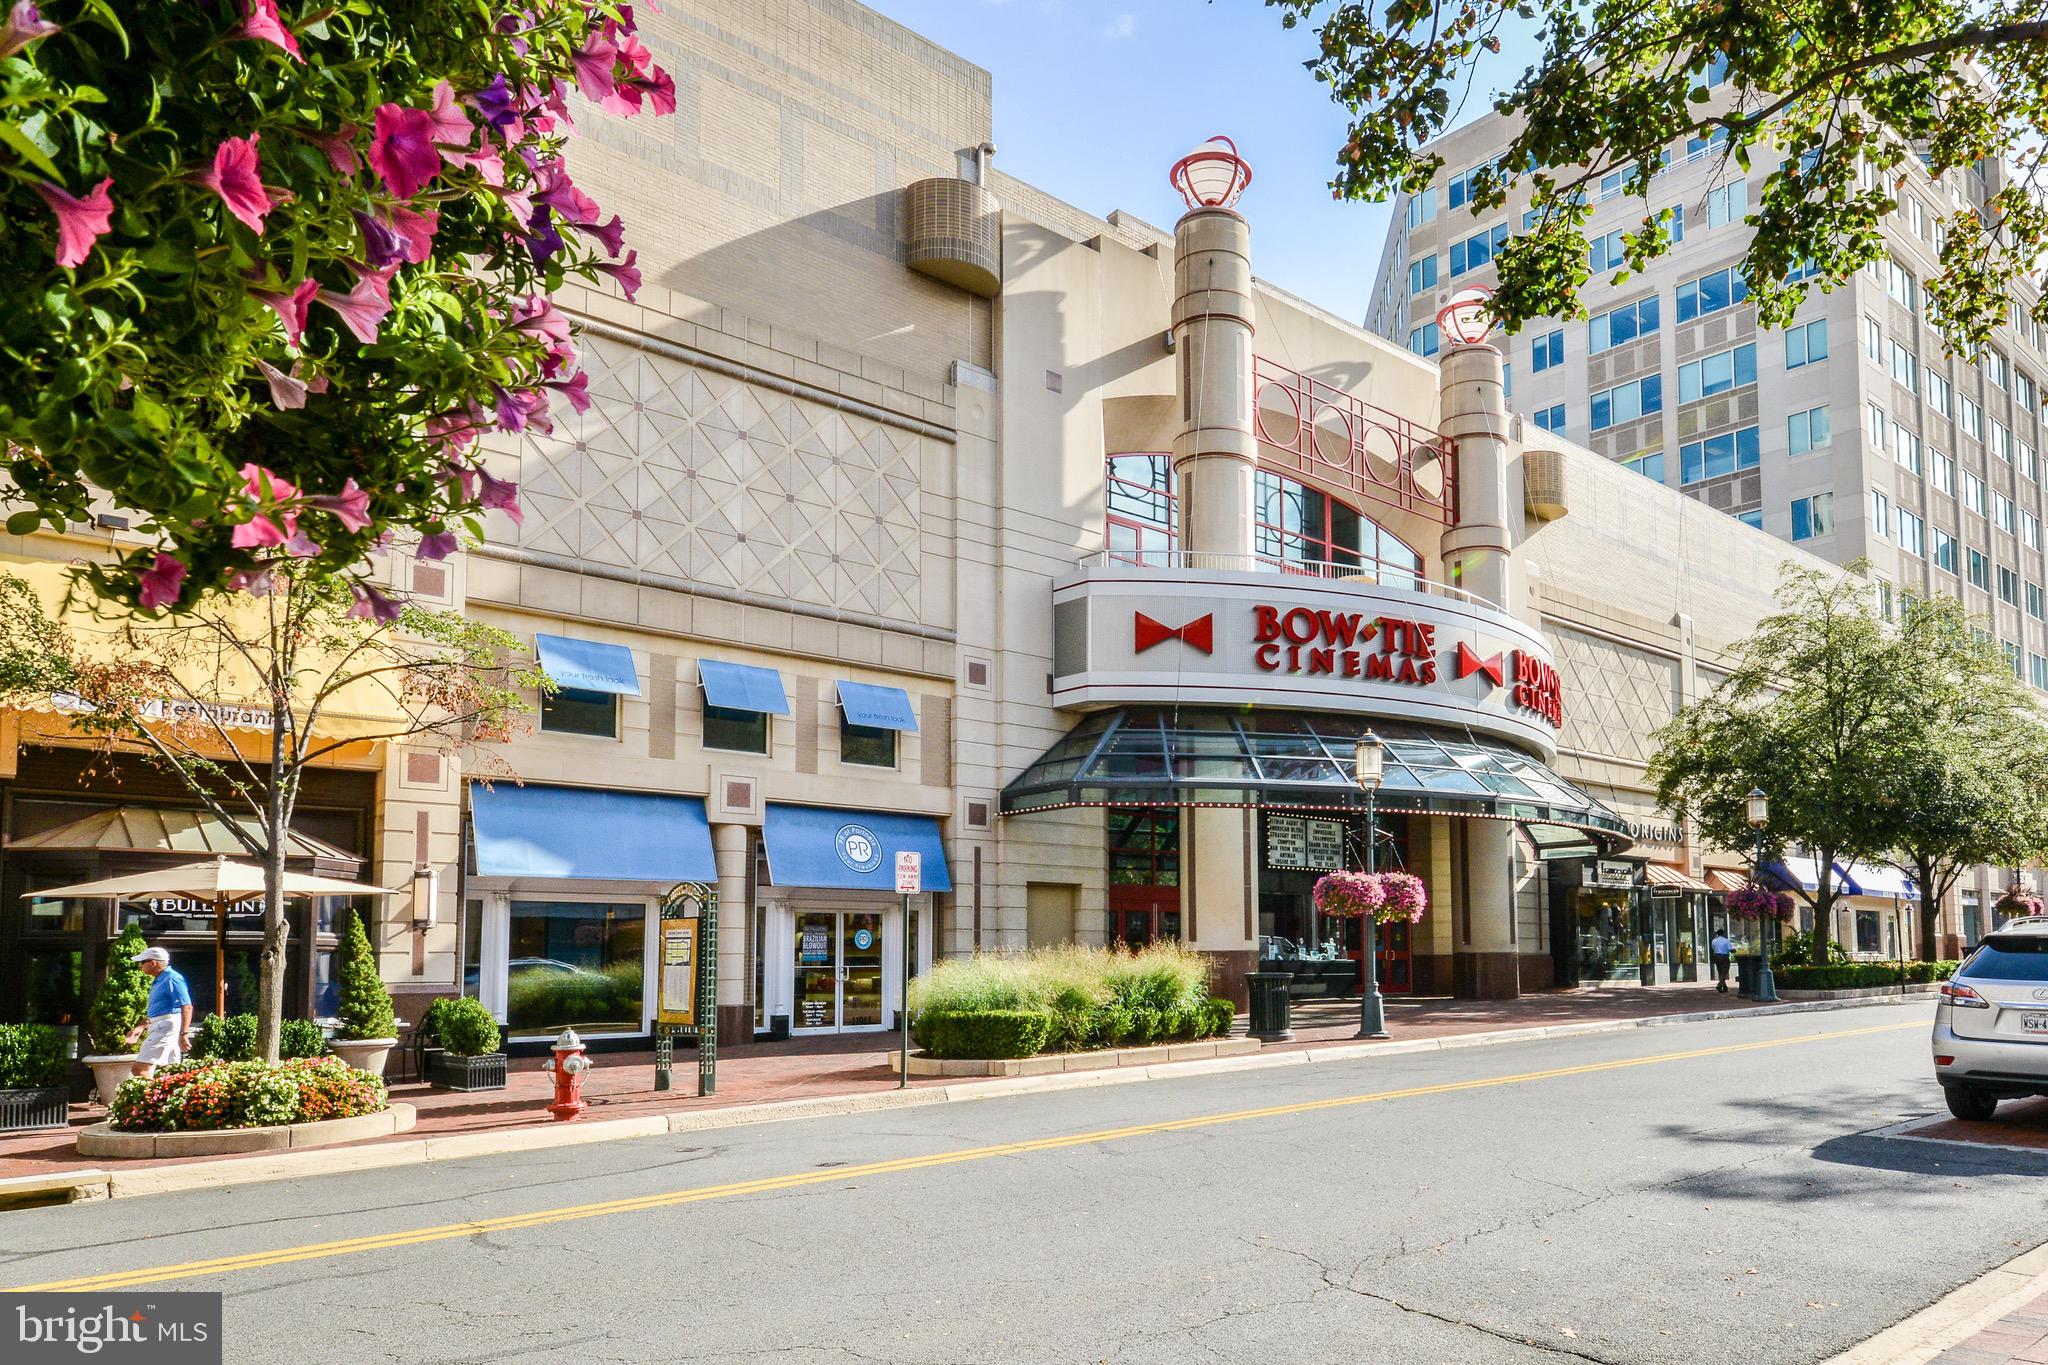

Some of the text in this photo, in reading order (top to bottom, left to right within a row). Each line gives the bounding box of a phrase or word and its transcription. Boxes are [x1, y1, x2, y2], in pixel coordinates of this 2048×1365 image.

[1253, 603, 1437, 660] BOW TIE
[1254, 642, 1438, 686] CINEMAS
[1630, 823, 1683, 842] ORIGINS
[847, 840, 869, 857] PR
[898, 864, 918, 873] PARKING
[903, 855, 913, 864] NO
